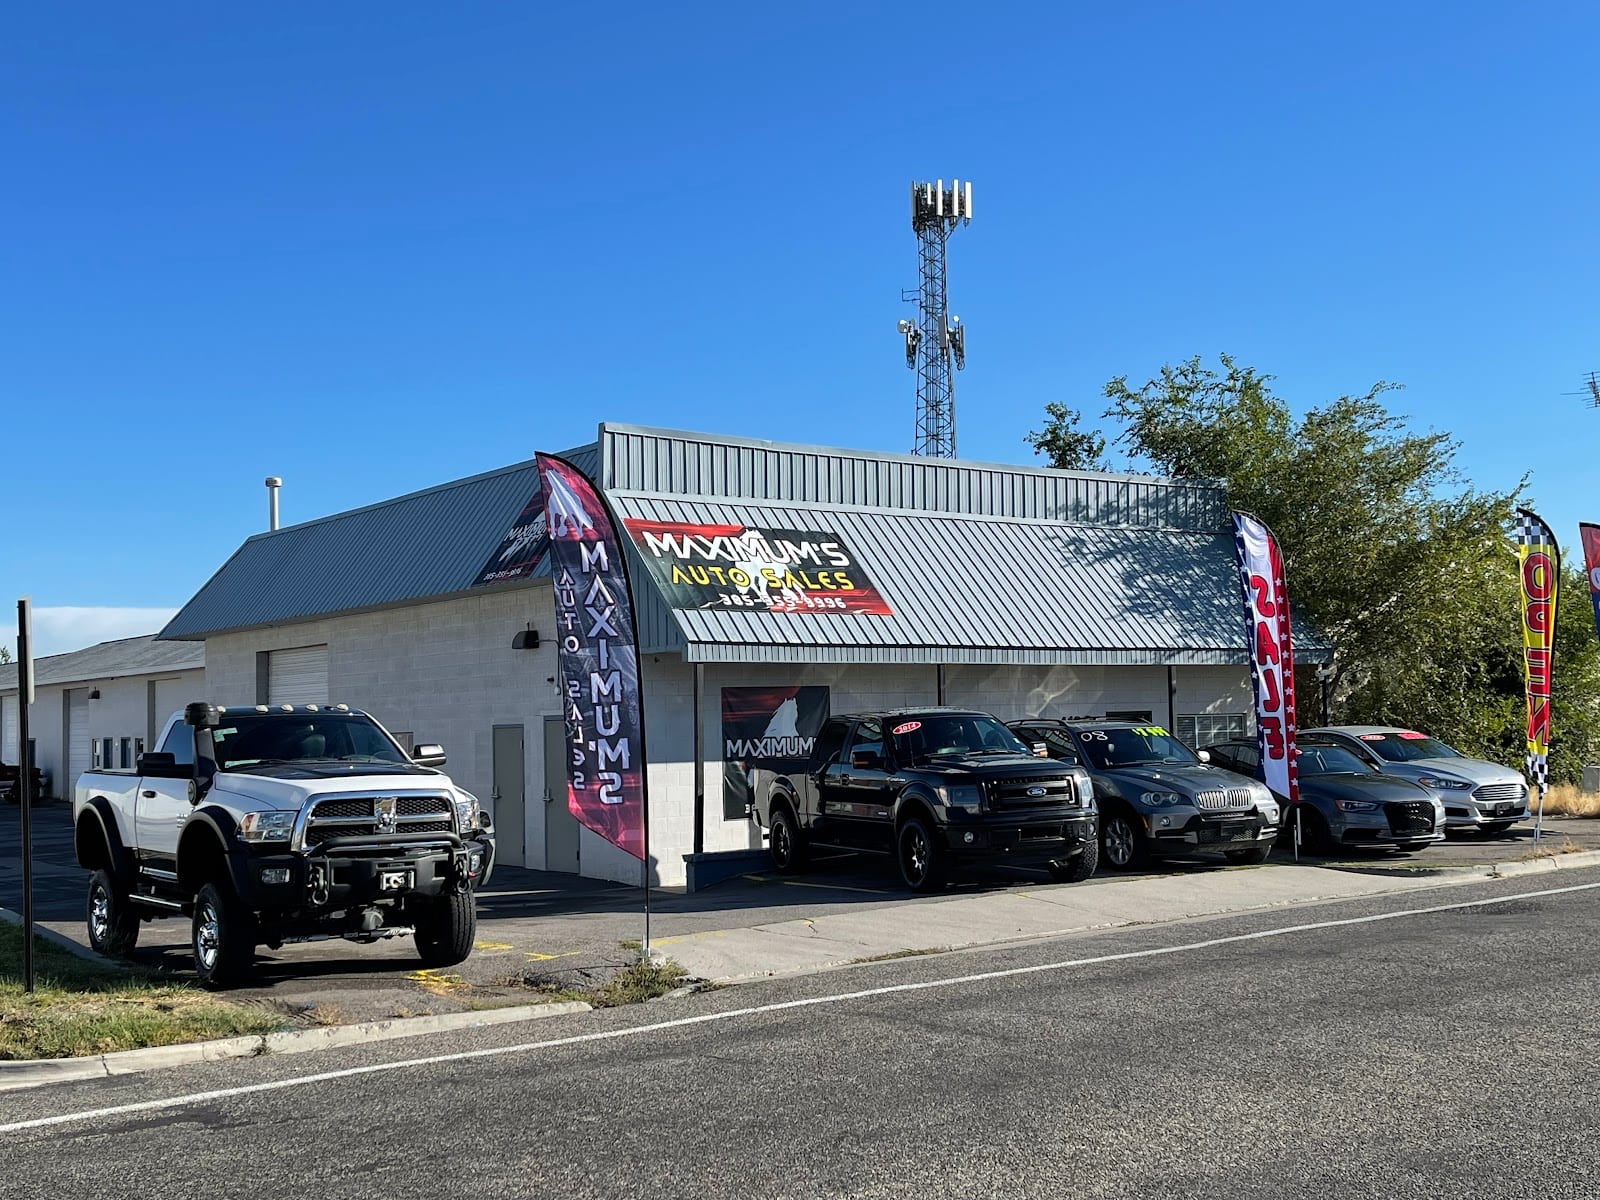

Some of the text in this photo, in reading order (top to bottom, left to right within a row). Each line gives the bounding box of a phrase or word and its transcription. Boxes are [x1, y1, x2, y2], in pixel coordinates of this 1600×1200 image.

[641, 530, 850, 567] MAXIMUM'S
[671, 564, 855, 591] AUTO SALES
[726, 736, 817, 758] MAXIMUM'
[1081, 730, 1109, 742] 08
